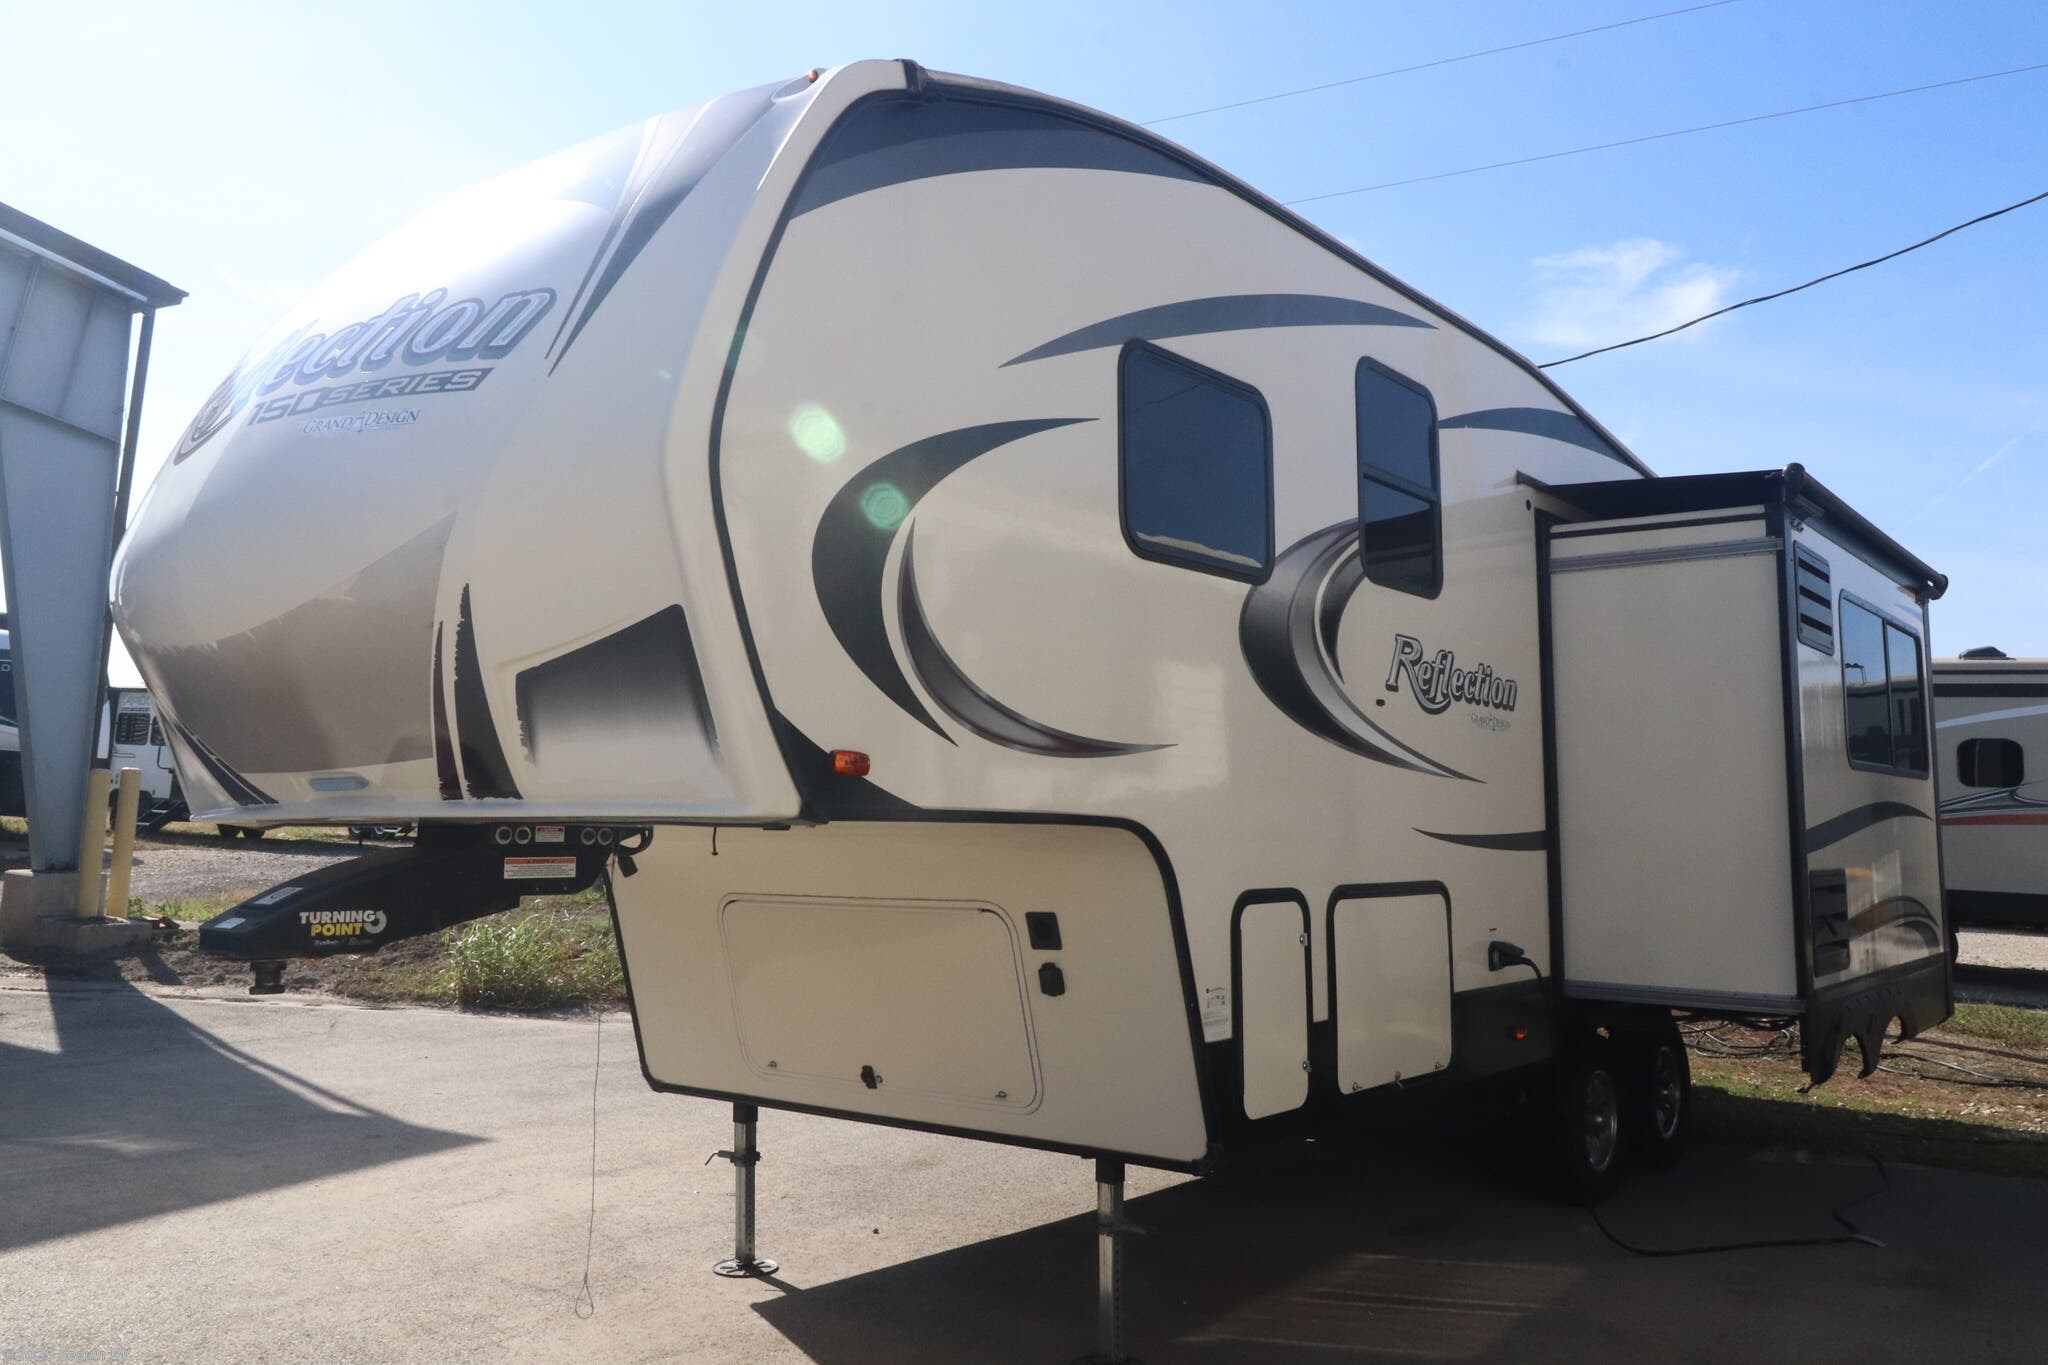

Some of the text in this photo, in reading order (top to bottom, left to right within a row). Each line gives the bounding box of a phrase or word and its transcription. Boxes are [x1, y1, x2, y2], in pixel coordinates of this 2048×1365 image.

[248, 369, 482, 426] 150 SERIES
[303, 409, 420, 434] GRAND DESIGN
[1385, 634, 1517, 715] Reflection
[299, 910, 376, 925] TURNING
[311, 923, 362, 937] POINT
